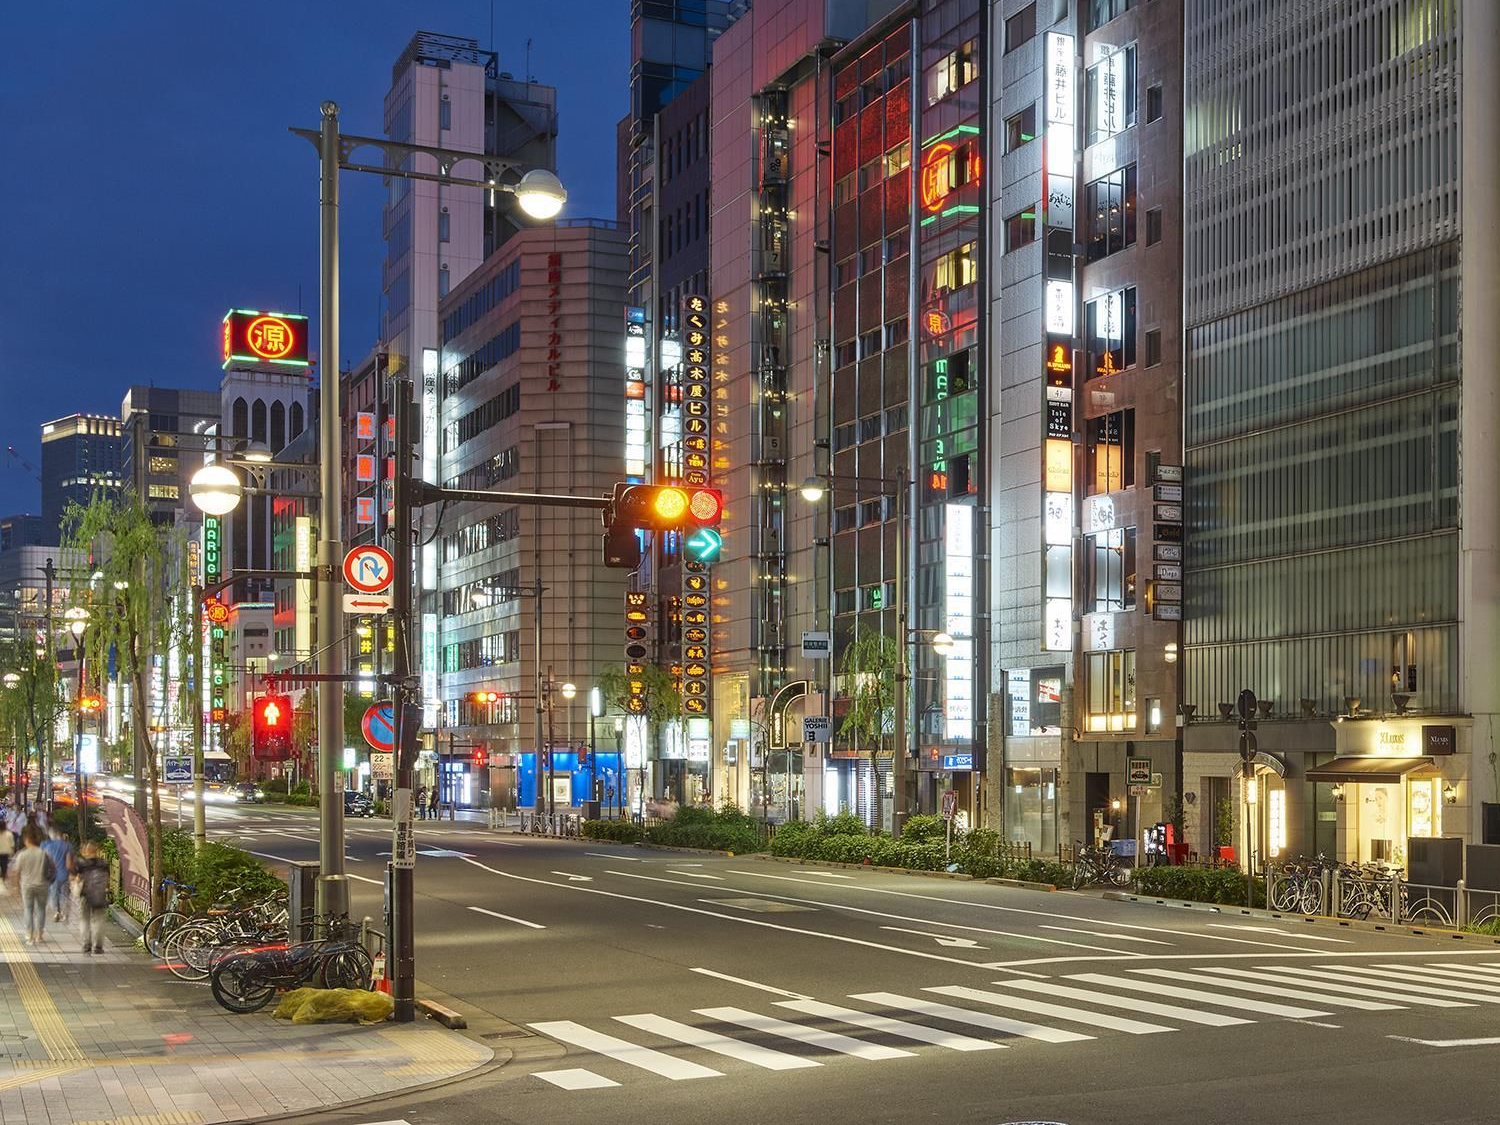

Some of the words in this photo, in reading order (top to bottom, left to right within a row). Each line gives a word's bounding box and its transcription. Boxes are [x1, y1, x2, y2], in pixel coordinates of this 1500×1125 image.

[255, 324, 285, 352] 源
[690, 298, 704, 432] たくみ高木屋ビル
[1049, 423, 1068, 431] Skye
[212, 710, 224, 720] 15
